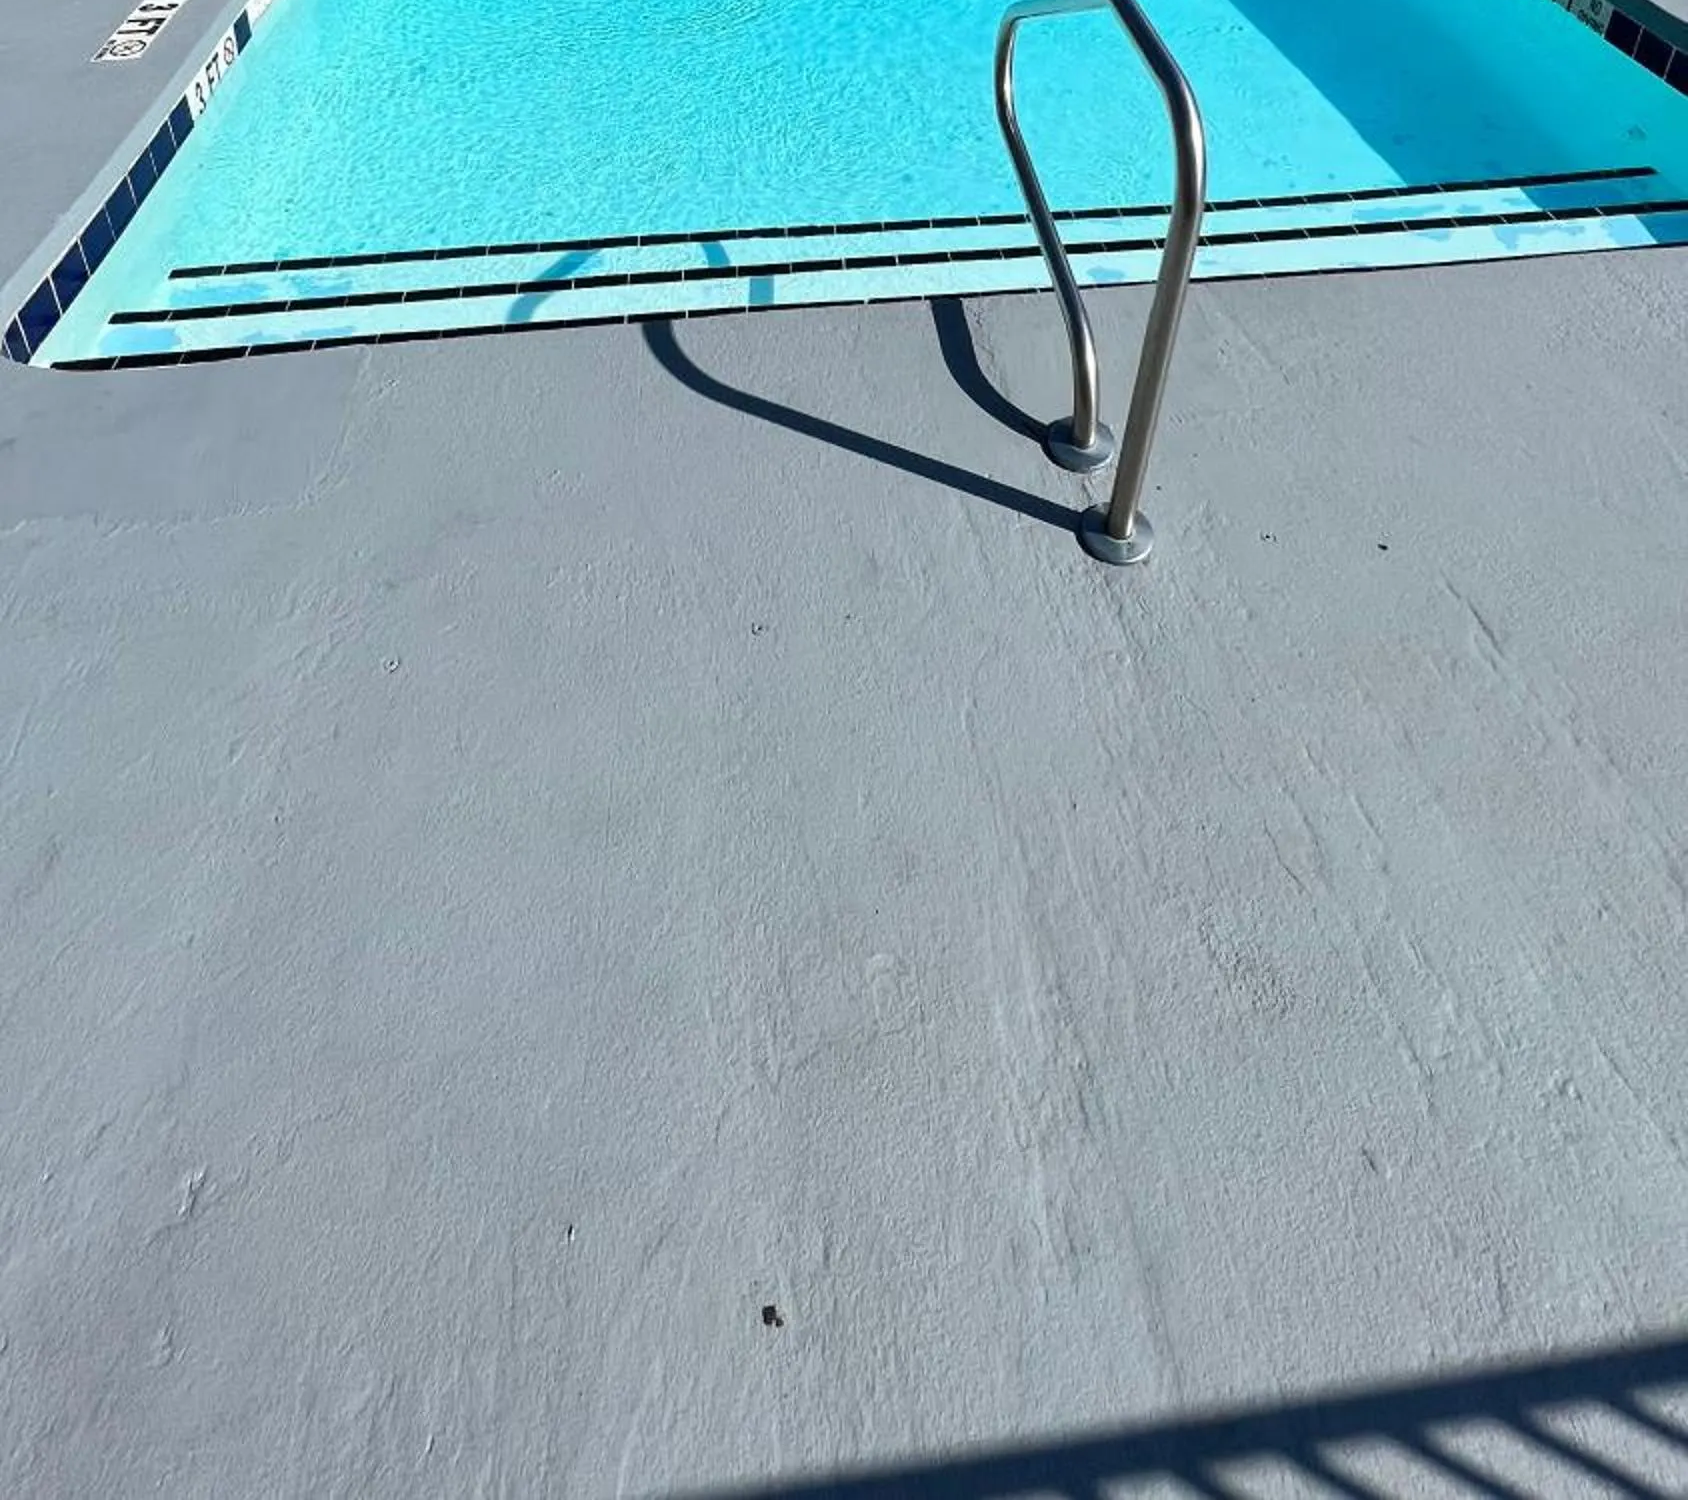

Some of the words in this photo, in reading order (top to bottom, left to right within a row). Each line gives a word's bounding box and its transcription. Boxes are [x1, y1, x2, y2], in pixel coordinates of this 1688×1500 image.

[138, 3, 180, 13] 3
[115, 17, 167, 37] FT
[205, 51, 221, 94] FT
